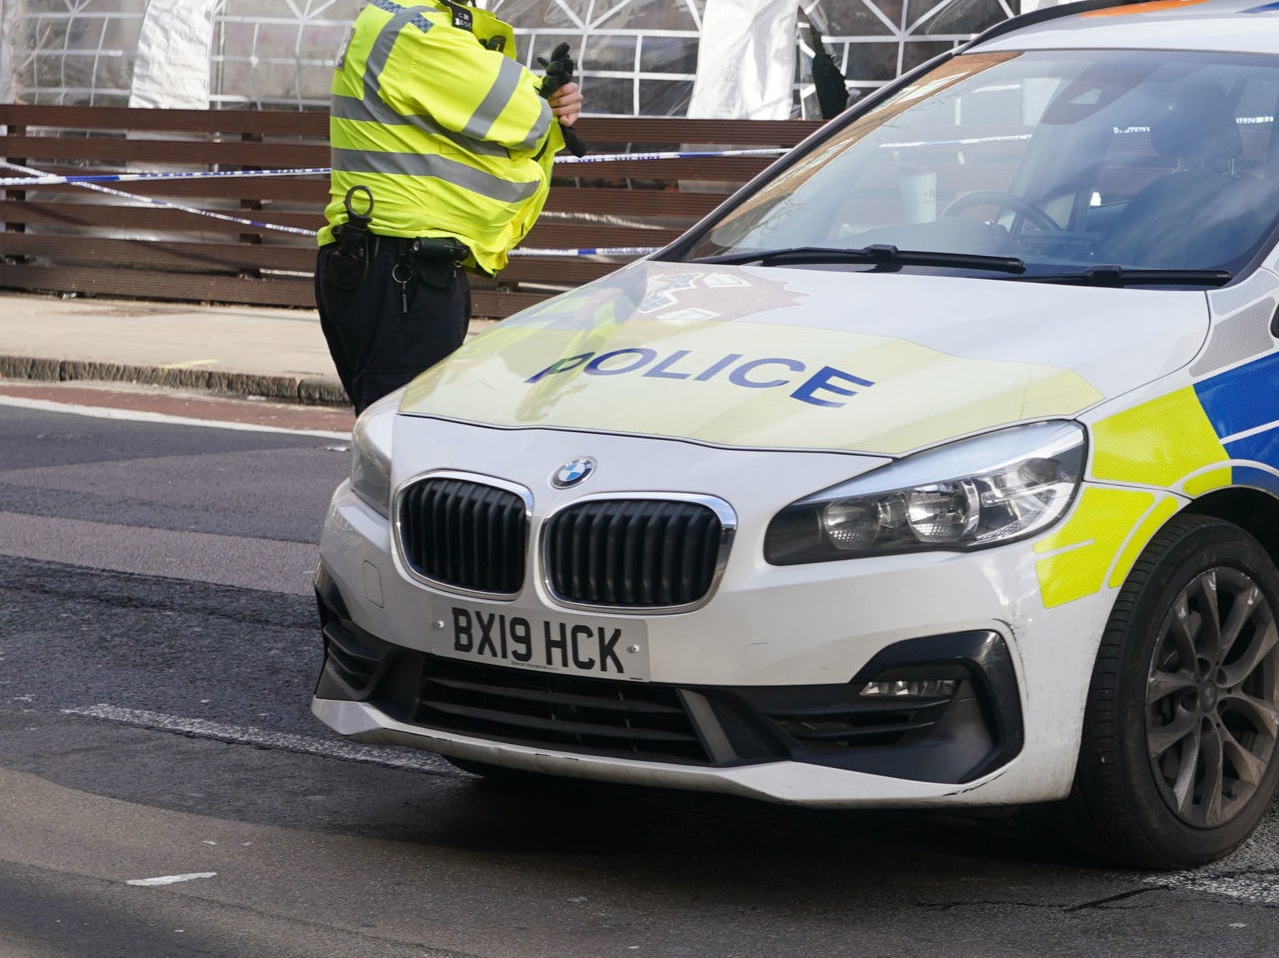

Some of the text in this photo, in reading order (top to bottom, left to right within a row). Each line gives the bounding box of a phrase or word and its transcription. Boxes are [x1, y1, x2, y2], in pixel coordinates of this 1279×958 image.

[524, 347, 875, 408] POLICE
[451, 606, 625, 674] BX19 HCK
